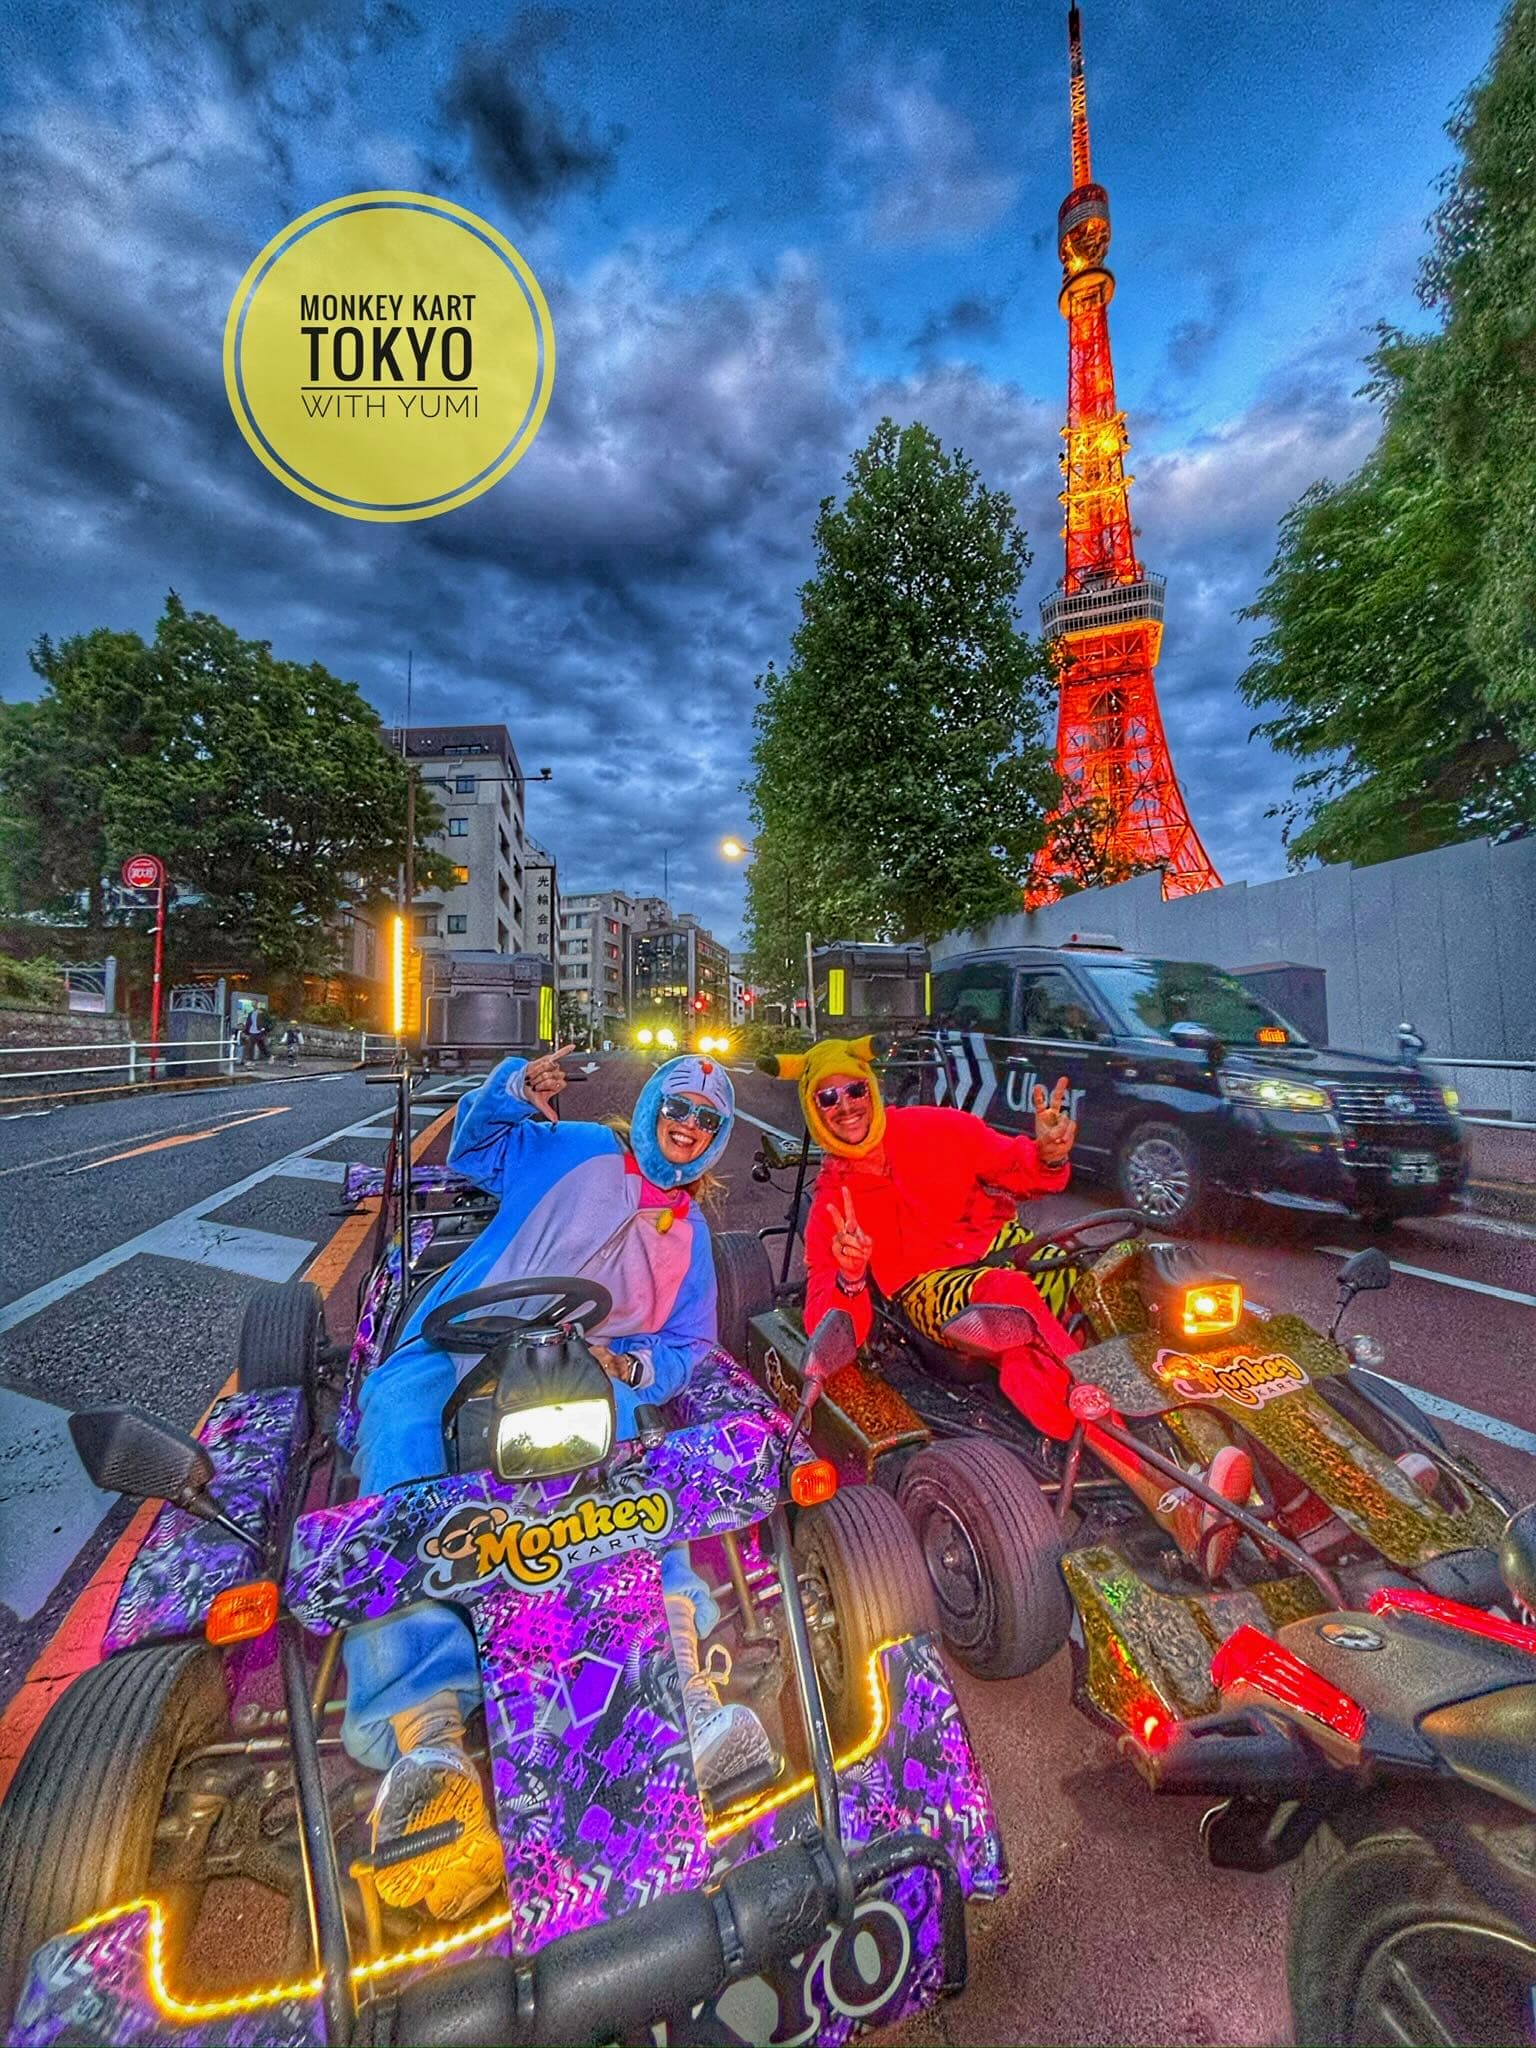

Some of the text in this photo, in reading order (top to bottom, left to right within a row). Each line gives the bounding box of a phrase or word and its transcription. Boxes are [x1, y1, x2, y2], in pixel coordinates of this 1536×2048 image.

[1006, 1070, 1087, 1121] Uber
[1197, 1356, 1304, 1405] Monkey
[1255, 1379, 1296, 1396] KART
[474, 1493, 669, 1584] Monkey
[566, 1533, 640, 1564] KART
